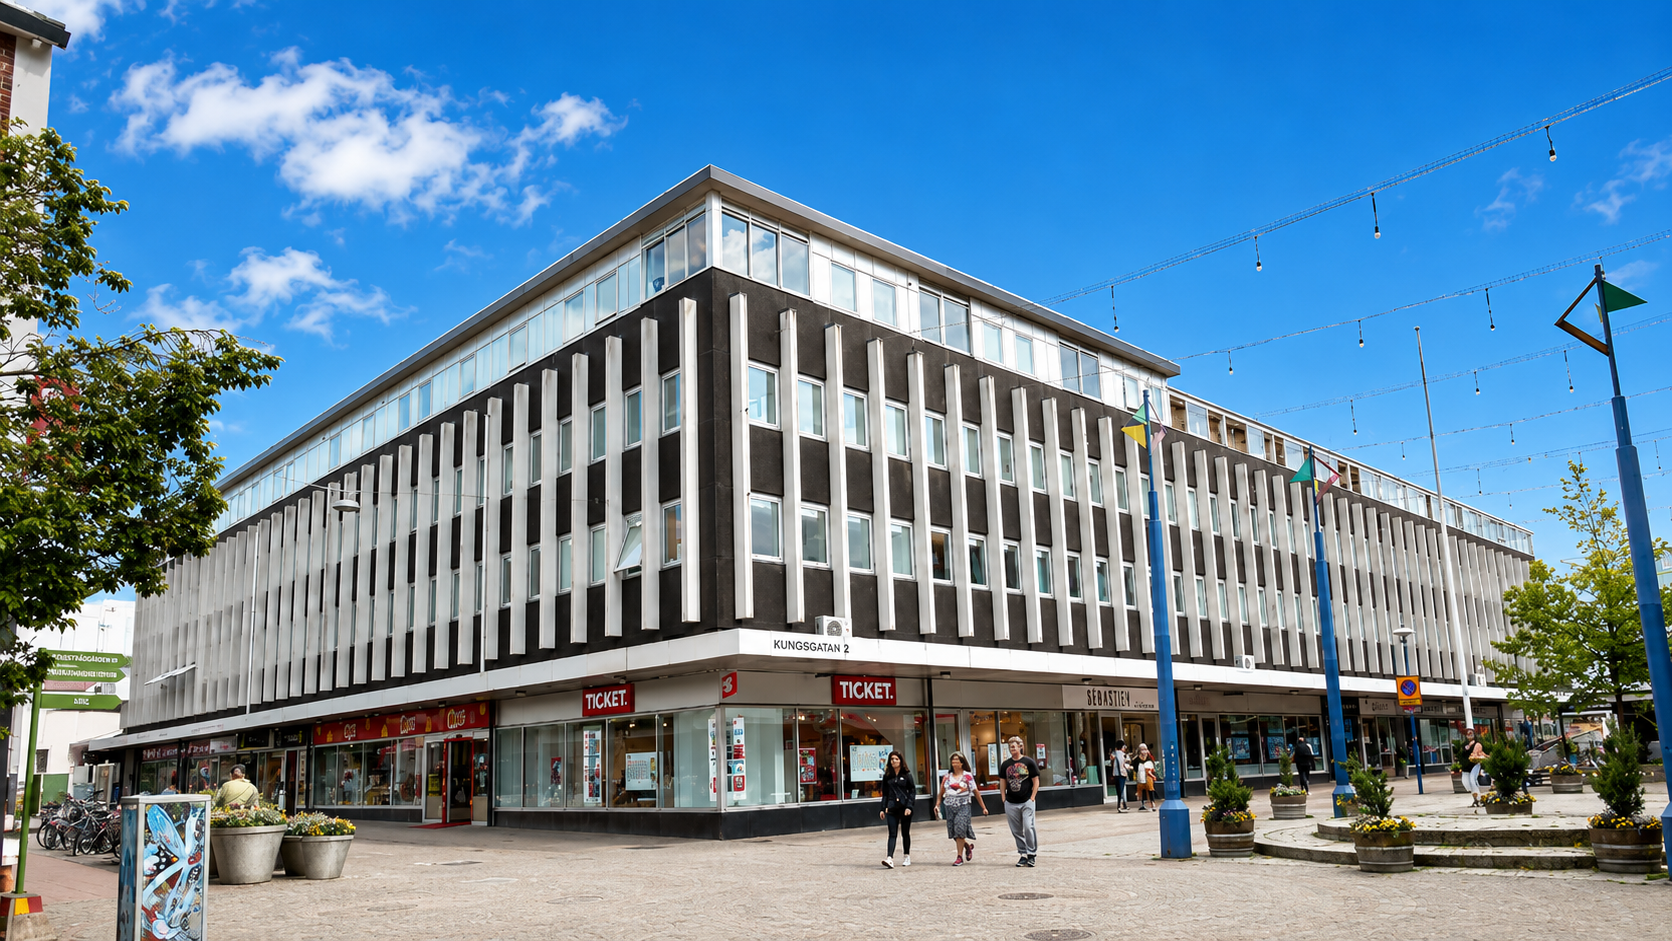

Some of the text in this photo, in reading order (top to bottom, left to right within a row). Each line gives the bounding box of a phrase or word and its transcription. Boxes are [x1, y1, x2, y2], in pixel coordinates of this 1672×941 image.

[773, 639, 850, 654] KUNGSGATAN 2
[585, 689, 628, 710] TICKET.
[839, 681, 894, 700] TICKET.
